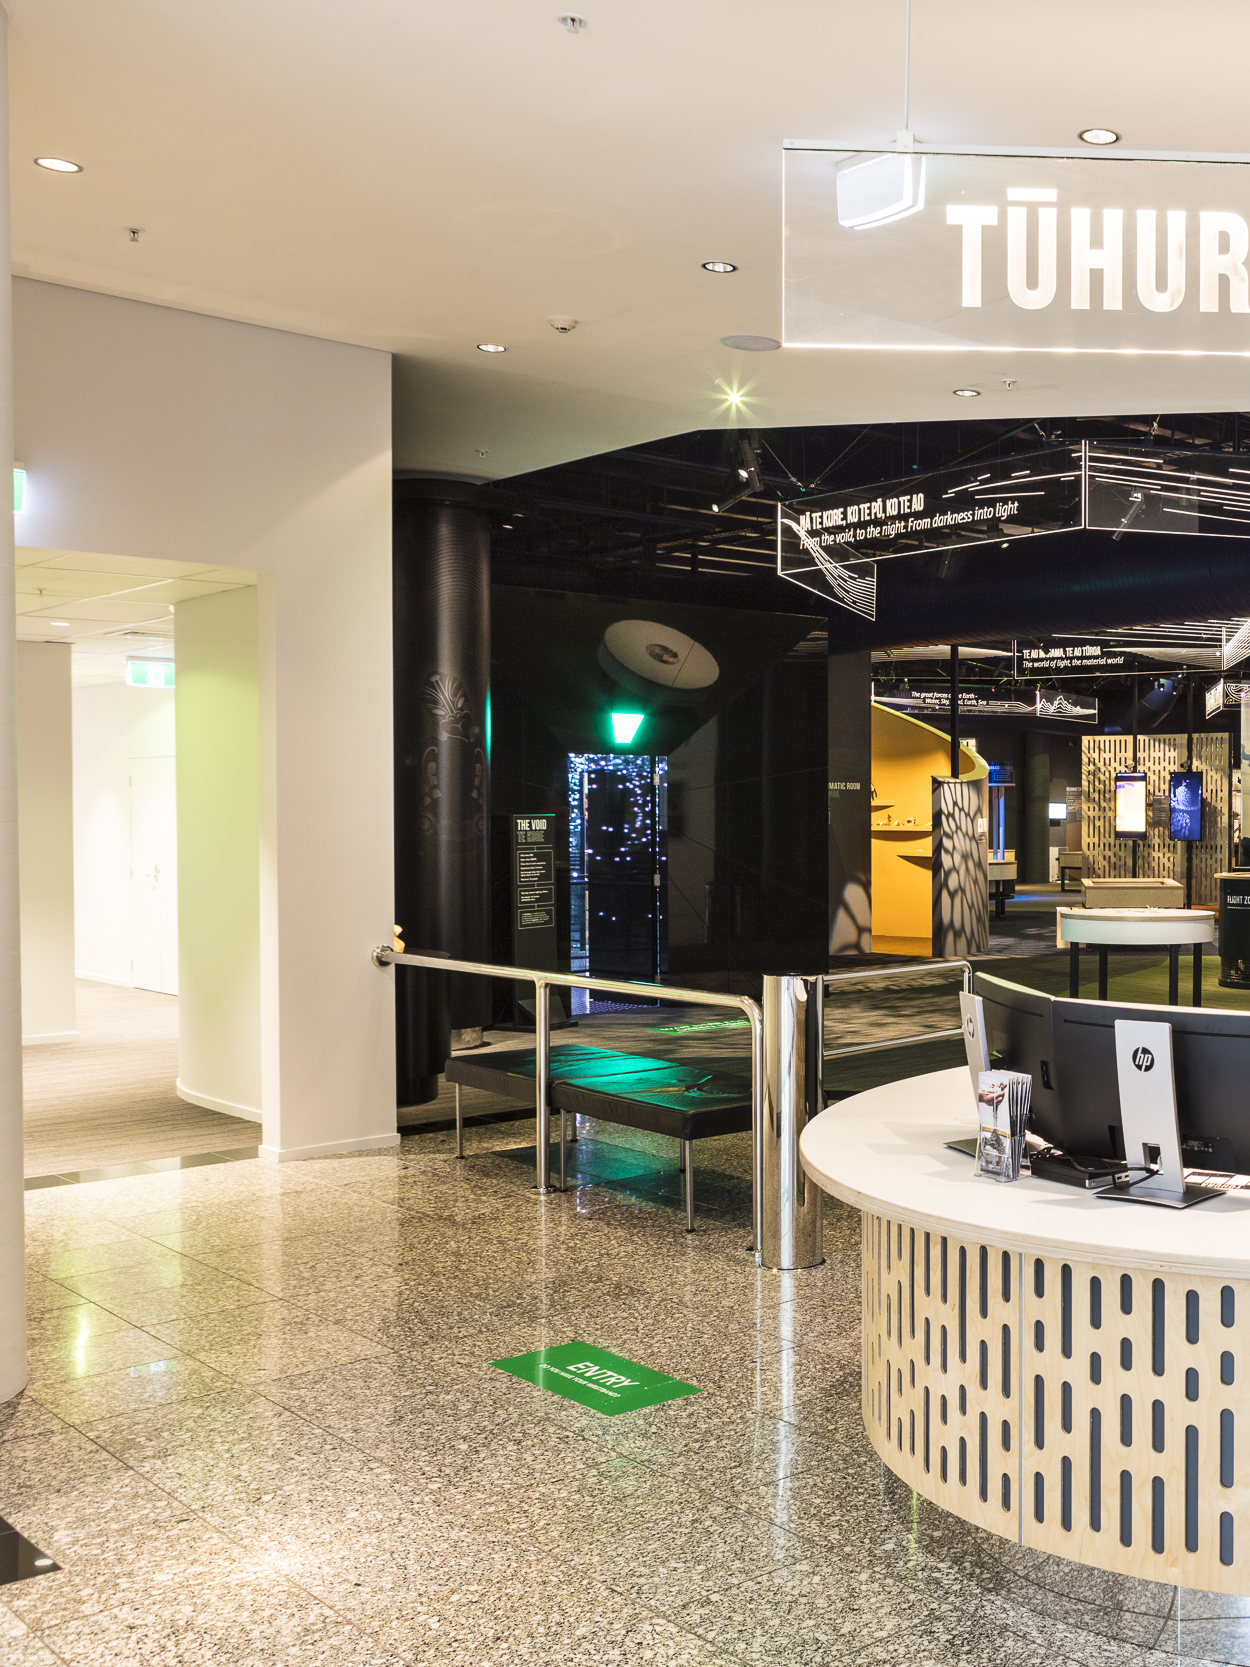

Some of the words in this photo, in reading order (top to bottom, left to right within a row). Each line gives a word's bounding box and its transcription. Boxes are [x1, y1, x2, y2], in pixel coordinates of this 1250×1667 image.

[812, 512, 822, 530] TE
[822, 507, 846, 529] KORE,
[847, 505, 859, 526] KO
[859, 503, 870, 522] TE
[871, 498, 885, 519] PŌ,
[886, 498, 898, 517] KO
[898, 495, 910, 515] TE
[911, 493, 925, 514] AO
[821, 529, 835, 547] the
[836, 526, 855, 545] void,
[856, 526, 866, 541] to
[867, 523, 880, 540] the
[882, 521, 906, 539] night.
[908, 516, 931, 532] From
[932, 510, 973, 529] darkness
[974, 505, 993, 521] into
[995, 500, 1019, 521] light
[1022, 649, 1031, 659] TE
[1066, 647, 1073, 656] TE
[1074, 646, 1082, 656] AO
[1022, 660, 1033, 668] The
[1034, 659, 1049, 668] world
[1050, 659, 1057, 669] of
[1072, 658, 1081, 666] the
[1107, 656, 1124, 664] world
[828, 782, 846, 790] MATIC
[847, 782, 861, 790] ROOM
[516, 819, 530, 831] THE
[531, 818, 547, 831] VOID
[1227, 895, 1243, 904] FLIGHT
[1135, 1047, 1152, 1072] hp
[566, 1361, 640, 1389] ENTRY
